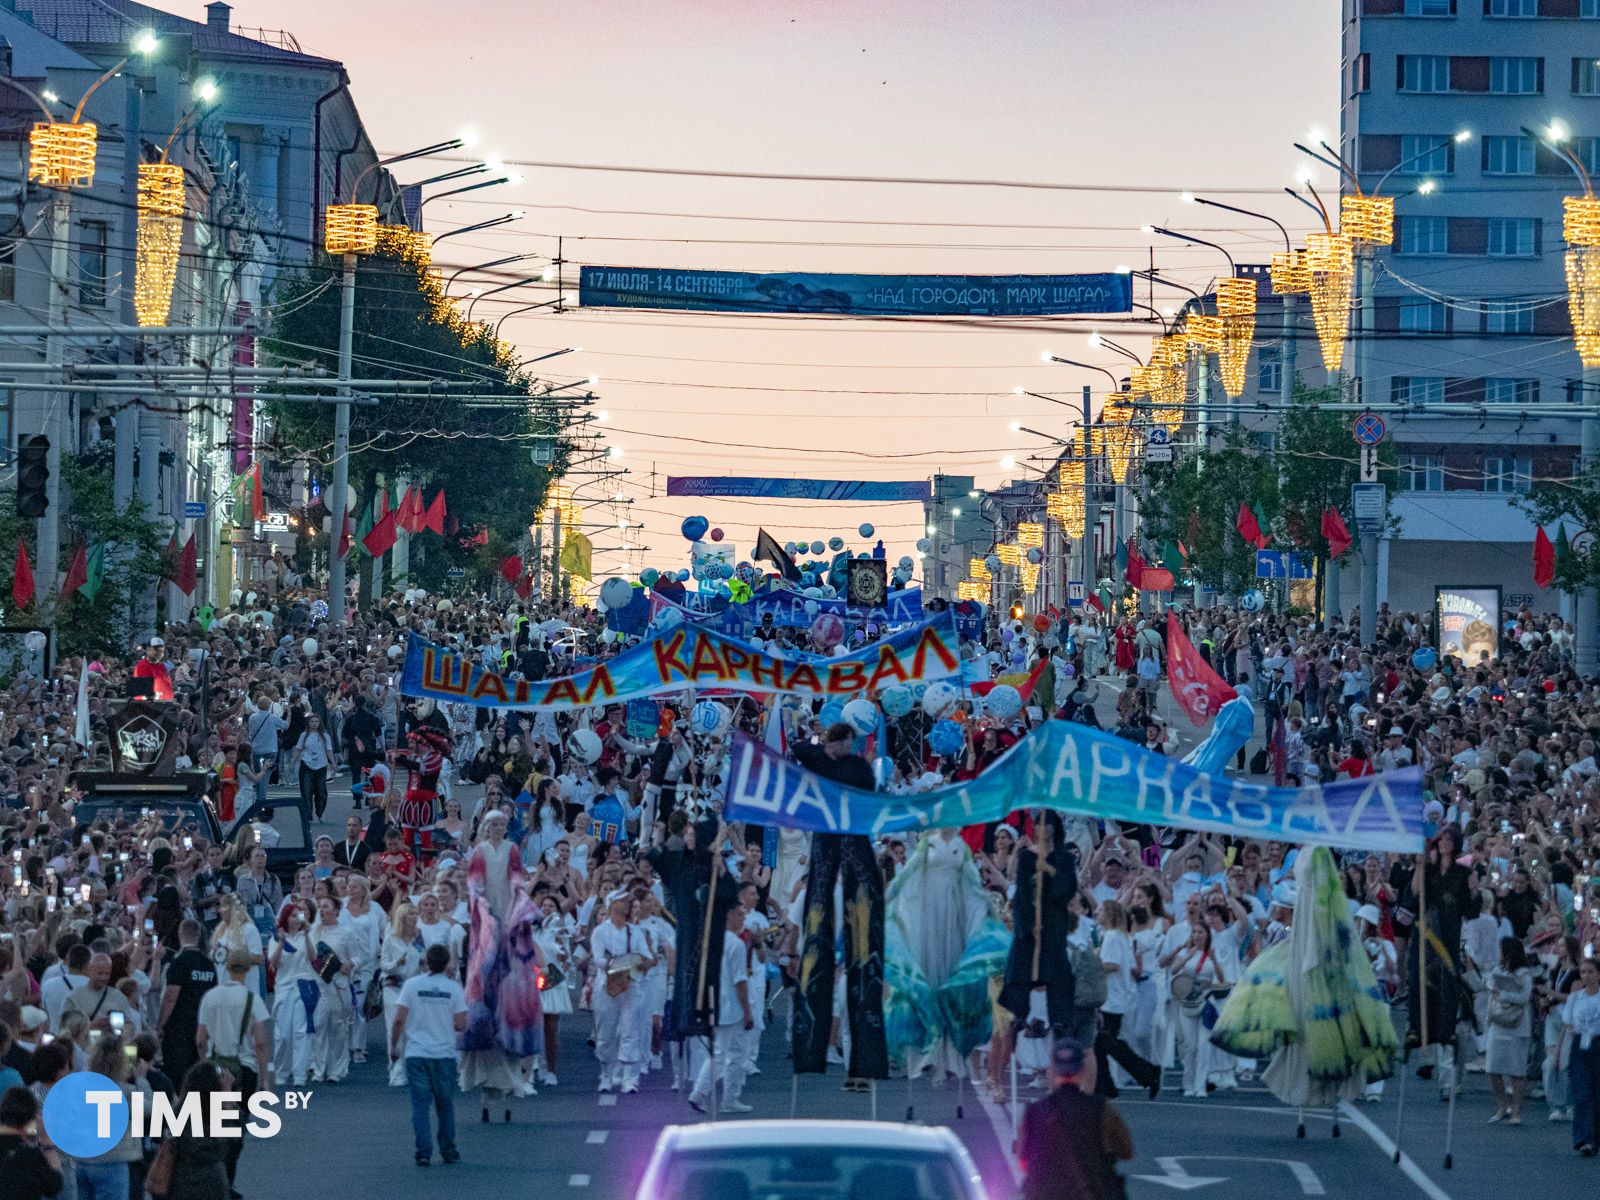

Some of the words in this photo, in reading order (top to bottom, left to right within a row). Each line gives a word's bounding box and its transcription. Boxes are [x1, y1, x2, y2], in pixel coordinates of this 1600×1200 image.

[588, 271, 604, 288] 17
[675, 275, 743, 295] СЕНТЯБРЯ
[1007, 287, 1046, 304] МАРК
[652, 625, 959, 695] КАРНАВАЛ
[1027, 733, 1409, 836] КАРНАВАЛ
[191, 969, 215, 982] STAFF
